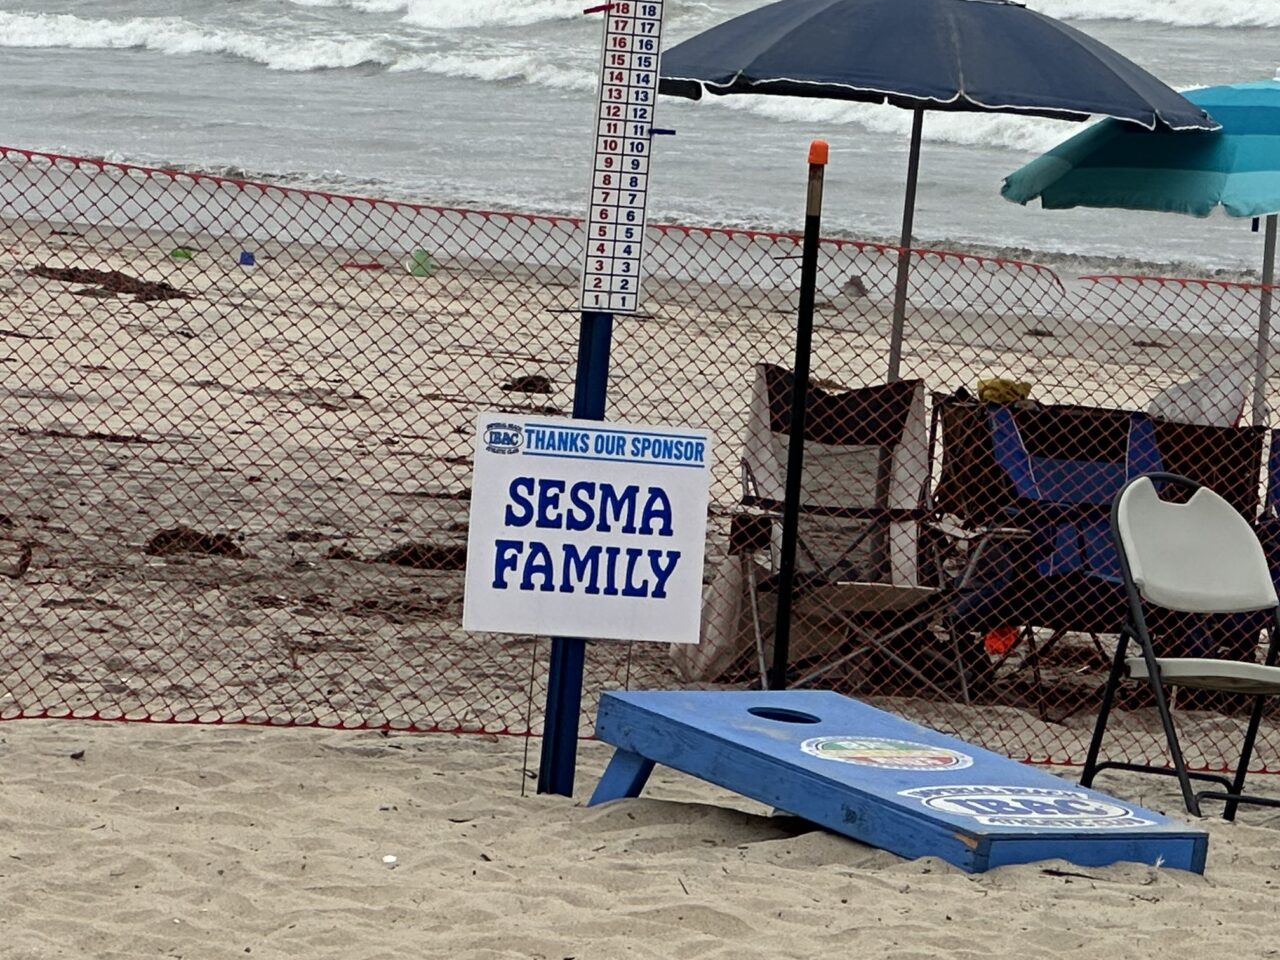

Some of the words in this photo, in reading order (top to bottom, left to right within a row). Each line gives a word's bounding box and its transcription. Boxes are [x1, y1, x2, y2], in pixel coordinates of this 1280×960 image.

[615, 2, 630, 14] 18
[642, 5, 656, 17] 18
[614, 19, 629, 31] 17
[641, 22, 655, 34] 17
[612, 36, 627, 49] 16
[639, 39, 653, 51] 16
[611, 54, 625, 66] 15
[637, 56, 652, 68] 15
[609, 71, 624, 83] 14
[636, 73, 650, 85] 14
[608, 88, 622, 100] 13
[634, 90, 649, 102] 13
[606, 105, 621, 117] 12
[633, 107, 647, 119] 12
[607, 122, 618, 134] 11
[633, 124, 644, 136] 11
[603, 139, 618, 151] 10
[630, 141, 644, 153] 10
[604, 157, 613, 168] 9
[631, 159, 640, 170] 9
[602, 174, 612, 186] 8
[629, 176, 638, 188] 8
[601, 191, 610, 203] 7
[628, 193, 637, 205] 7
[599, 208, 609, 220] 6
[626, 210, 635, 222] 6
[598, 225, 607, 237] 5
[625, 227, 634, 239] 5
[596, 243, 605, 254] 4
[623, 244, 632, 256] 4
[595, 260, 604, 271] 3
[622, 261, 630, 273] 3
[593, 277, 602, 289] 2
[620, 279, 629, 290] 2
[594, 294, 599, 305] 1
[621, 296, 626, 307] 1
[489, 431, 519, 445] IBAC
[525, 429, 589, 453] THANKS
[594, 434, 626, 457] OUR
[631, 438, 705, 462] SPONSOR
[505, 476, 674, 536] SESMA
[492, 539, 681, 599] FAMILY
[943, 798, 1108, 816] IBAC
